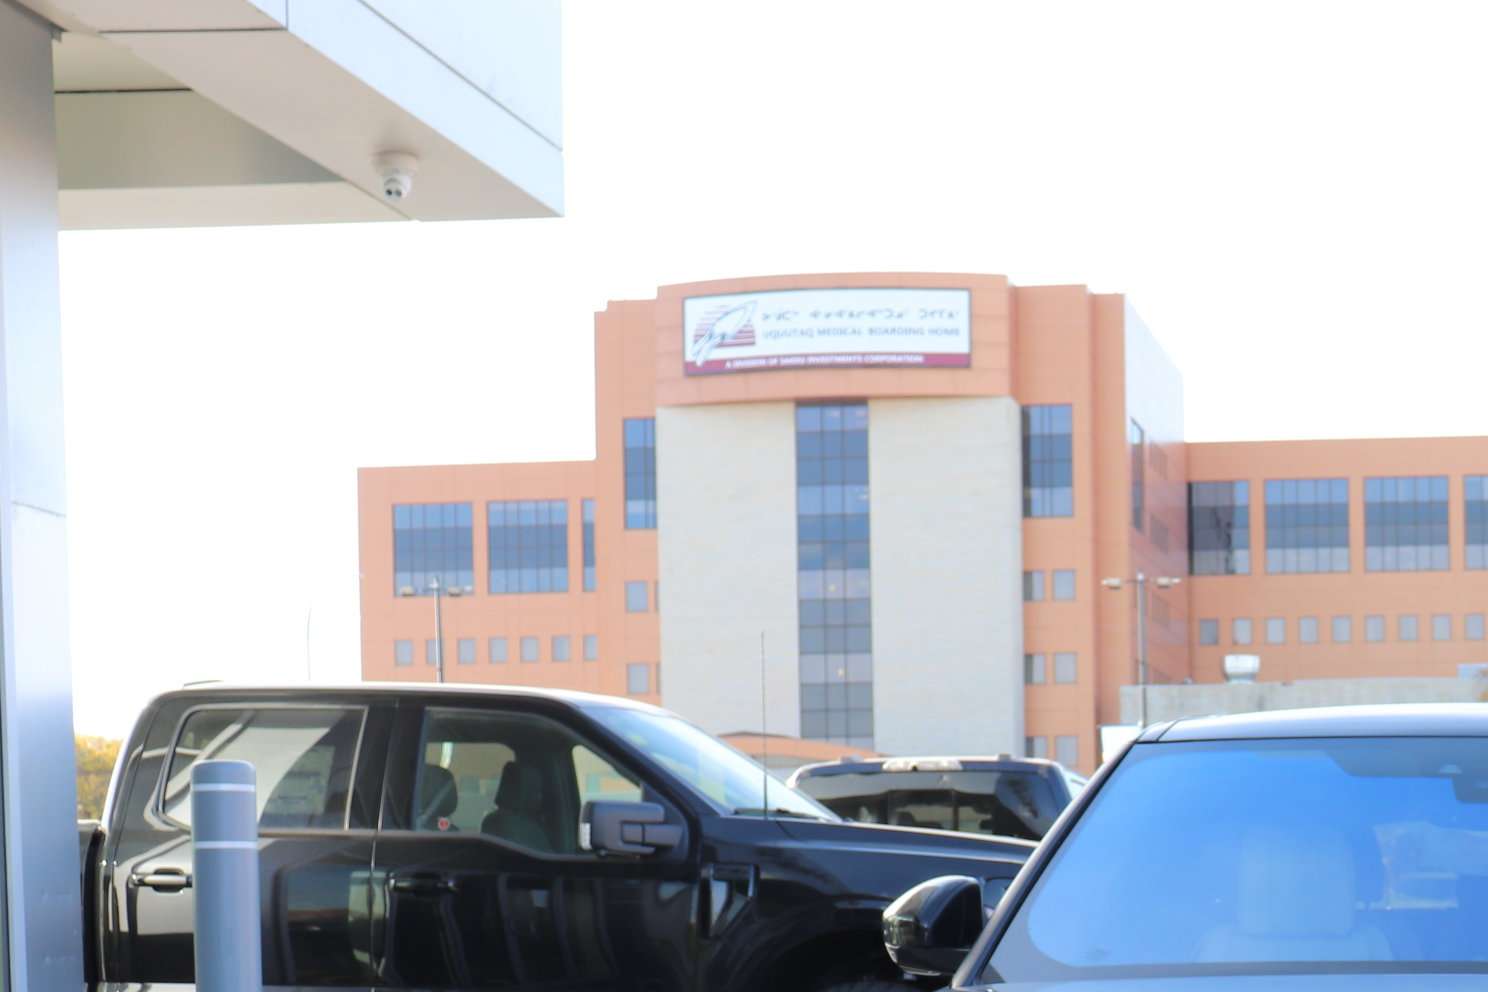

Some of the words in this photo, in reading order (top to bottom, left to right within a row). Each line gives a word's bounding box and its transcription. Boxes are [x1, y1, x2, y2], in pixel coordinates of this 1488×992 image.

[817, 327, 862, 337] MEDICAL
[868, 327, 925, 337] BOARDING
[928, 327, 960, 337] HOME
